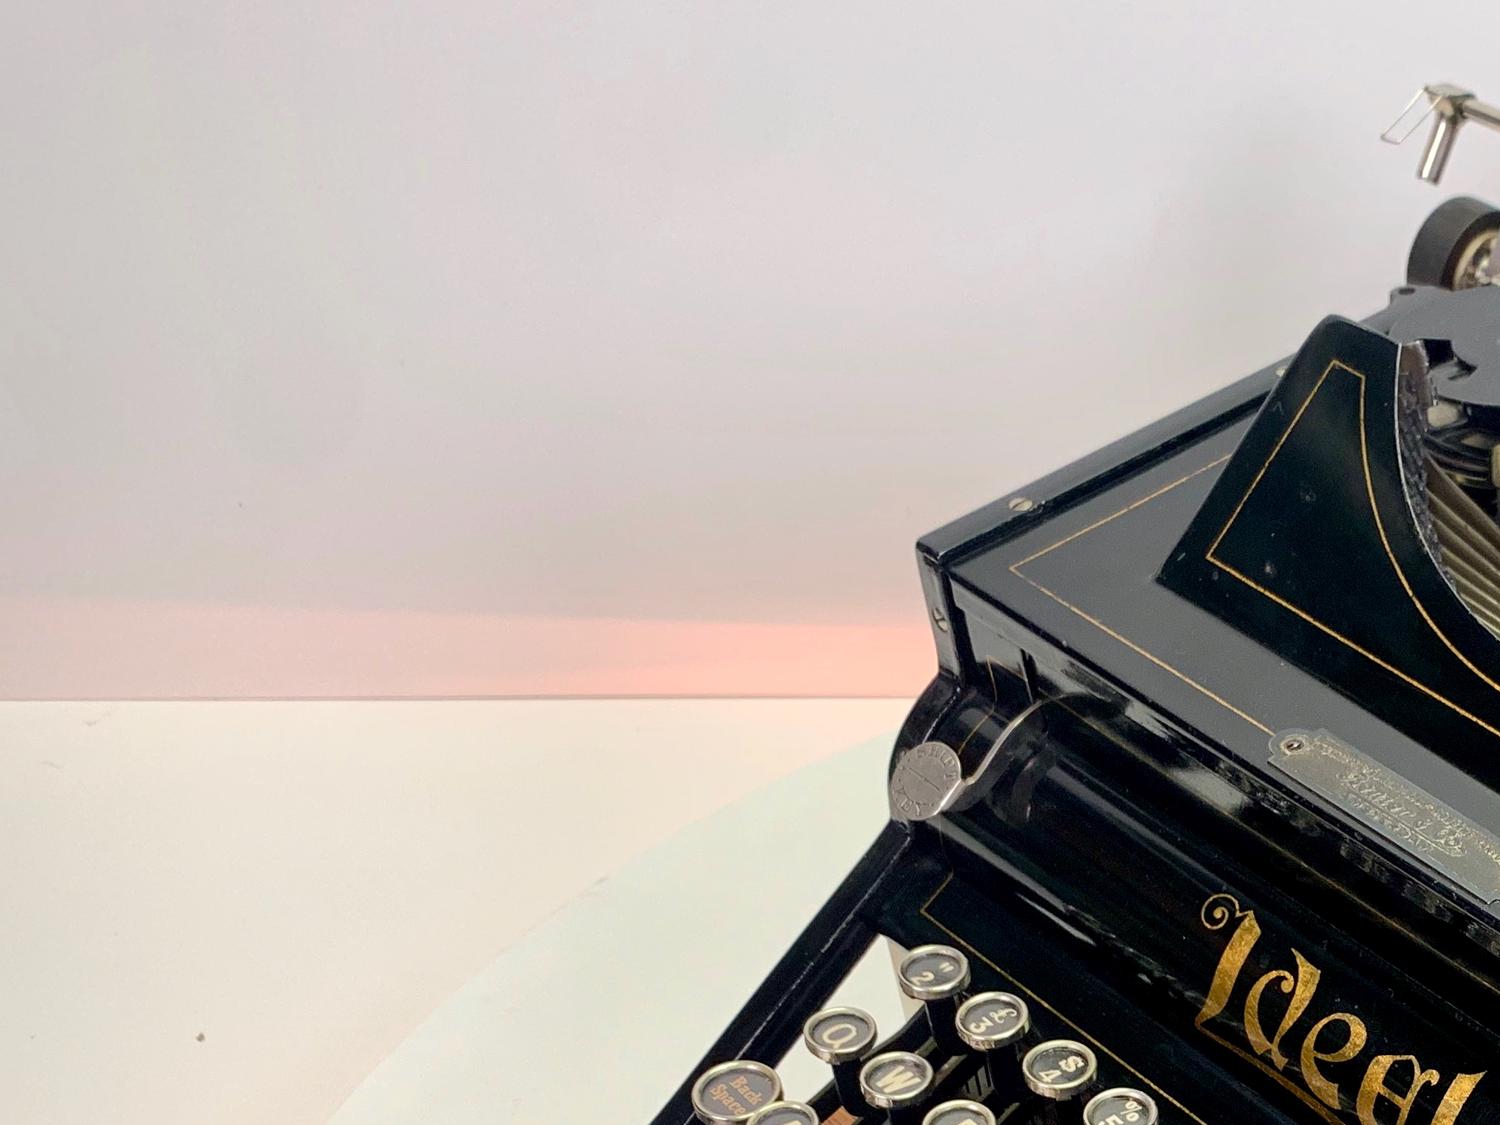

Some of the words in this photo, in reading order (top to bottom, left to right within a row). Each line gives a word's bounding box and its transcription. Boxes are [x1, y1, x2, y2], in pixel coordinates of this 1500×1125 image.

[910, 971, 935, 986] 2
[822, 1023, 857, 1049] Q
[969, 1017, 994, 1033] 3
[1059, 1055, 1084, 1072] $
[875, 1066, 921, 1094] W
[1039, 1070, 1062, 1082] 4
[710, 1084, 746, 1116] Space
[729, 1075, 764, 1105] Back
[1120, 1099, 1143, 1121] %
